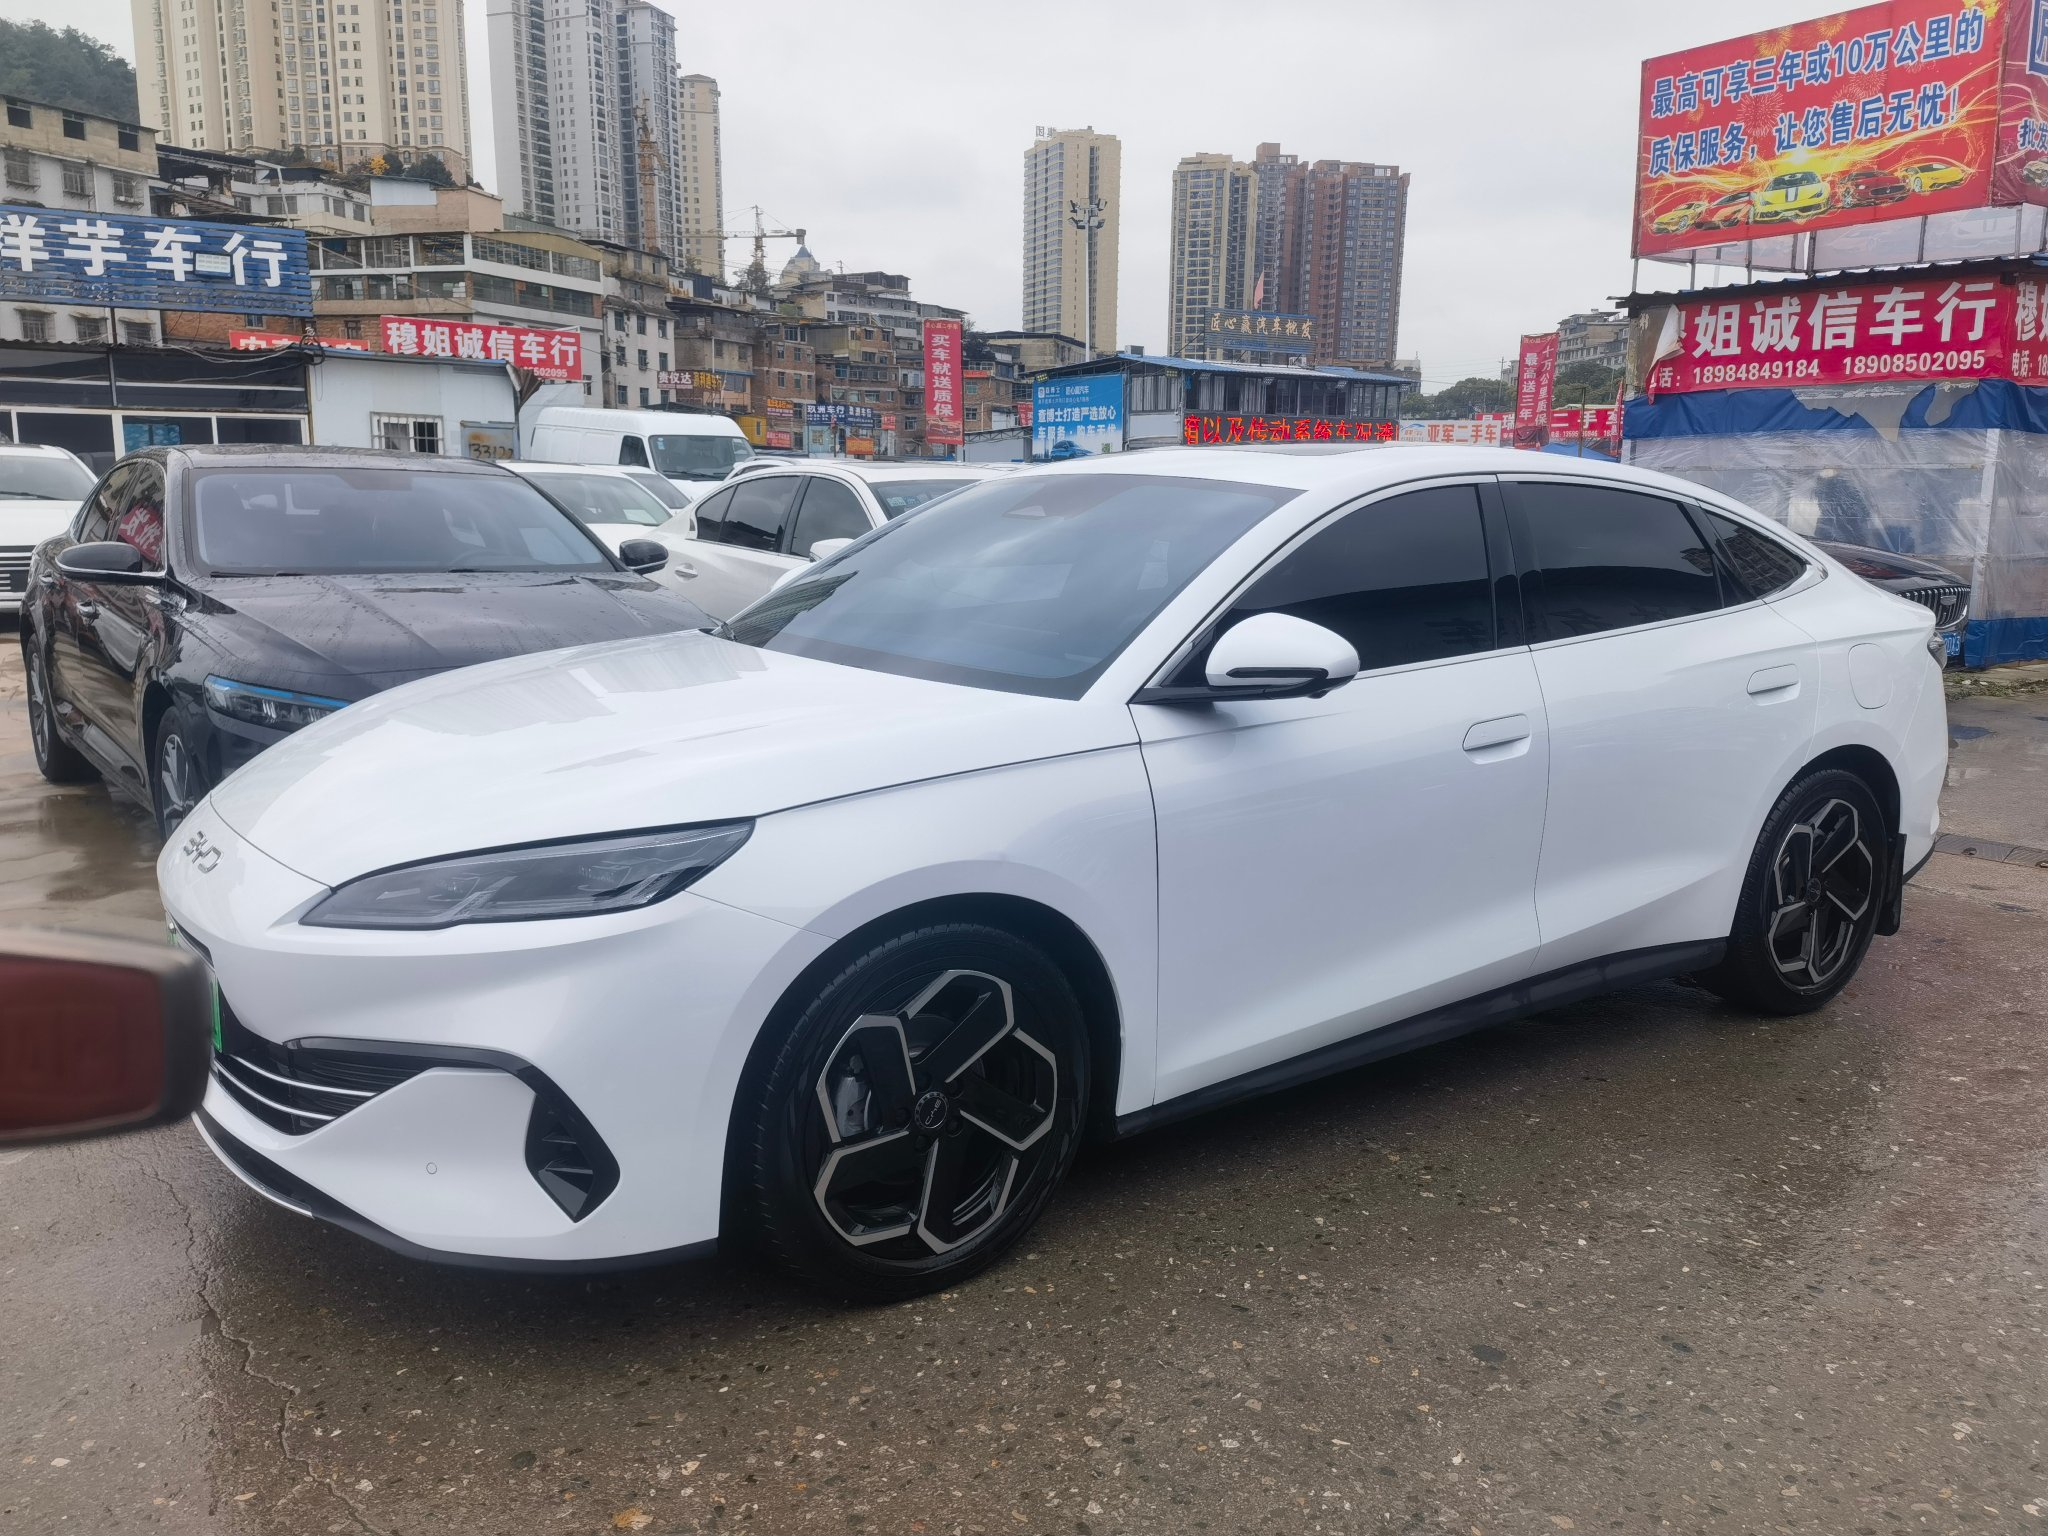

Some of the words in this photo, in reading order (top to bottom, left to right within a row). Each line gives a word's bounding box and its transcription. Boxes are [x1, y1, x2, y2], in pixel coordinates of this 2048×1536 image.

[1651, 8, 1986, 118] 最高可享三年或10万公里的
[387, 322, 577, 367] 穆姐诚信车行
[1679, 282, 1996, 358] 姐诚信车行
[931, 334, 953, 416] 买车就送质保
[1519, 353, 1538, 420] 最高送三年
[1535, 345, 1554, 426] 十万公里质保
[1693, 359, 1819, 385] 18984849184
[1843, 350, 1985, 376] 18908502095
[1038, 405, 1116, 423] 查博士打造严选放心
[1427, 423, 1497, 443] 亚军二手车
